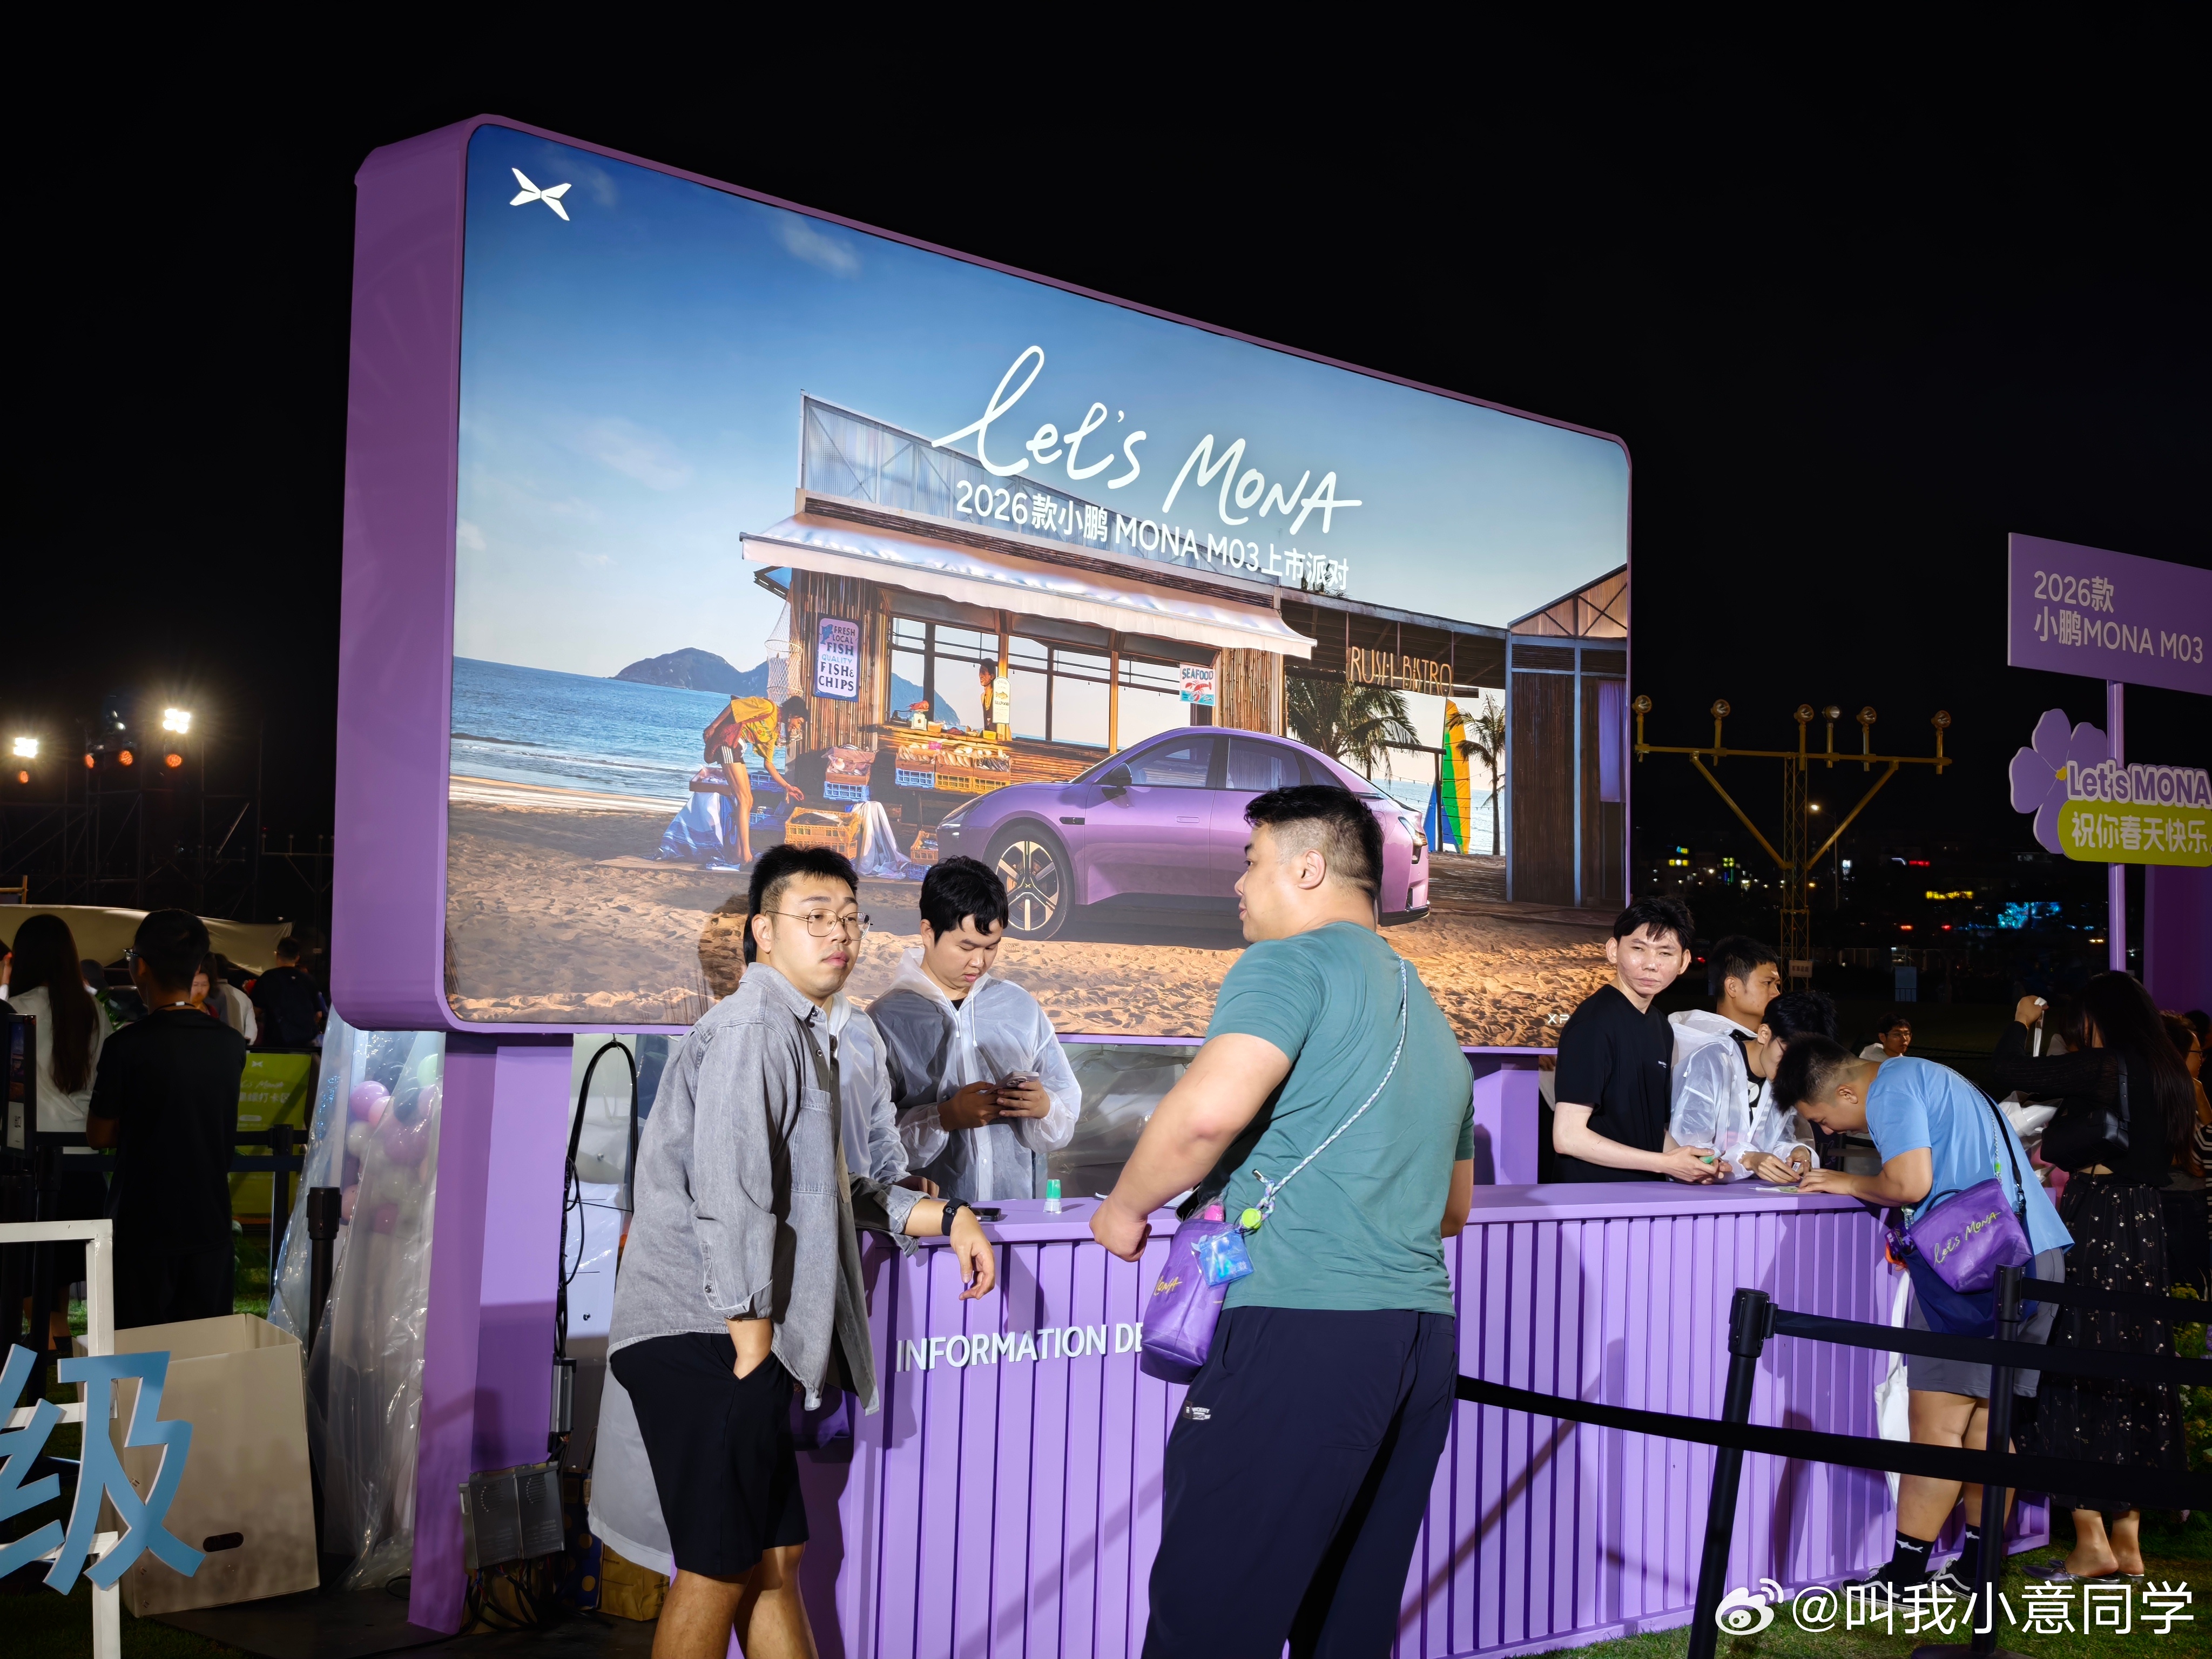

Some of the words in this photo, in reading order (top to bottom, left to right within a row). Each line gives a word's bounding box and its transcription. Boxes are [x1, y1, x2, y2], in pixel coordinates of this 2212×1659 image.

[932, 345, 1147, 489] Let's
[956, 480, 1108, 543] 2026款小鹏
[1115, 513, 1200, 561] MONA
[2034, 570, 2114, 613] 2026款
[827, 642, 854, 656] FISH
[832, 635, 853, 644] LOCAL
[834, 625, 855, 637] FRESH
[2161, 630, 2203, 664] M03
[821, 653, 853, 664] QUALITY
[1182, 667, 1213, 680] SEAFOOD
[819, 675, 854, 692] CHIPS
[2068, 761, 2130, 801] Let's
[2134, 770, 2211, 806] MONA
[2072, 811, 2208, 853] 祝你春天快乐
[895, 1324, 1107, 1372] INFORMATION
[0, 1343, 206, 1596] 级
